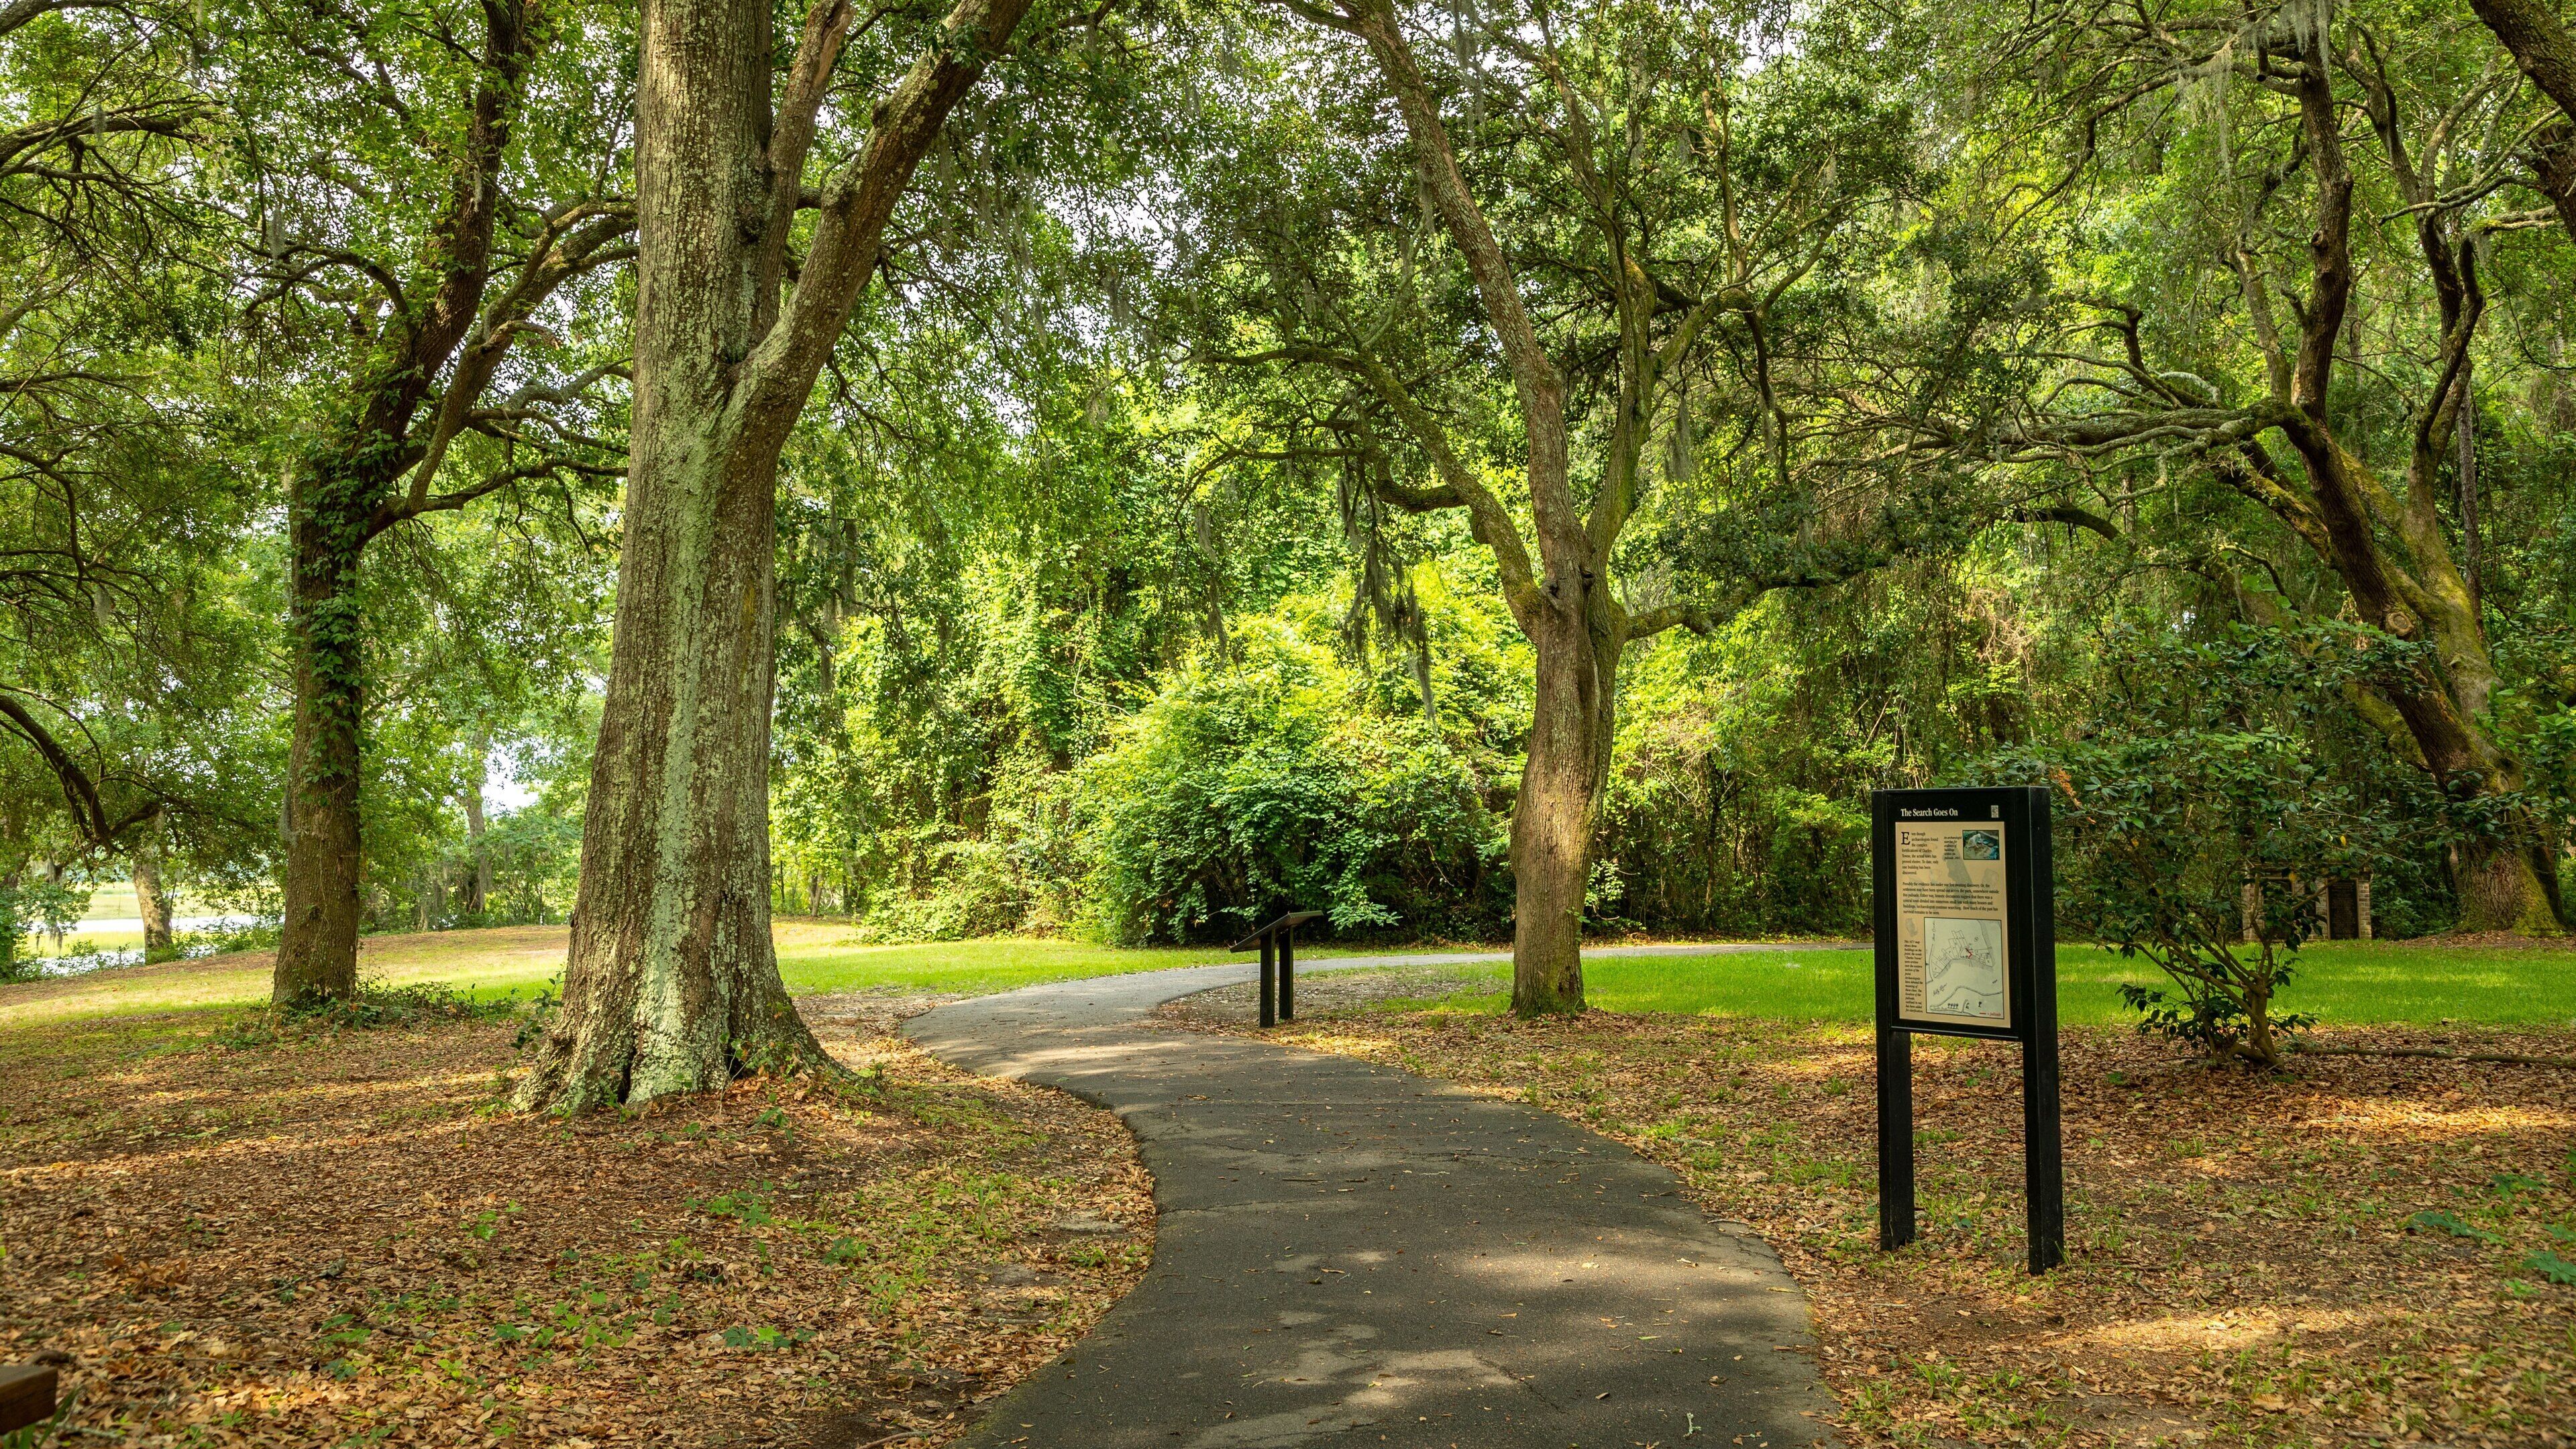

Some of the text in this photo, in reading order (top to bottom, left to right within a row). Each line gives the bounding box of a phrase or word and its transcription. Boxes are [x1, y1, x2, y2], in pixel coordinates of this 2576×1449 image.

[1900, 808, 1958, 816] The Search Goes On
